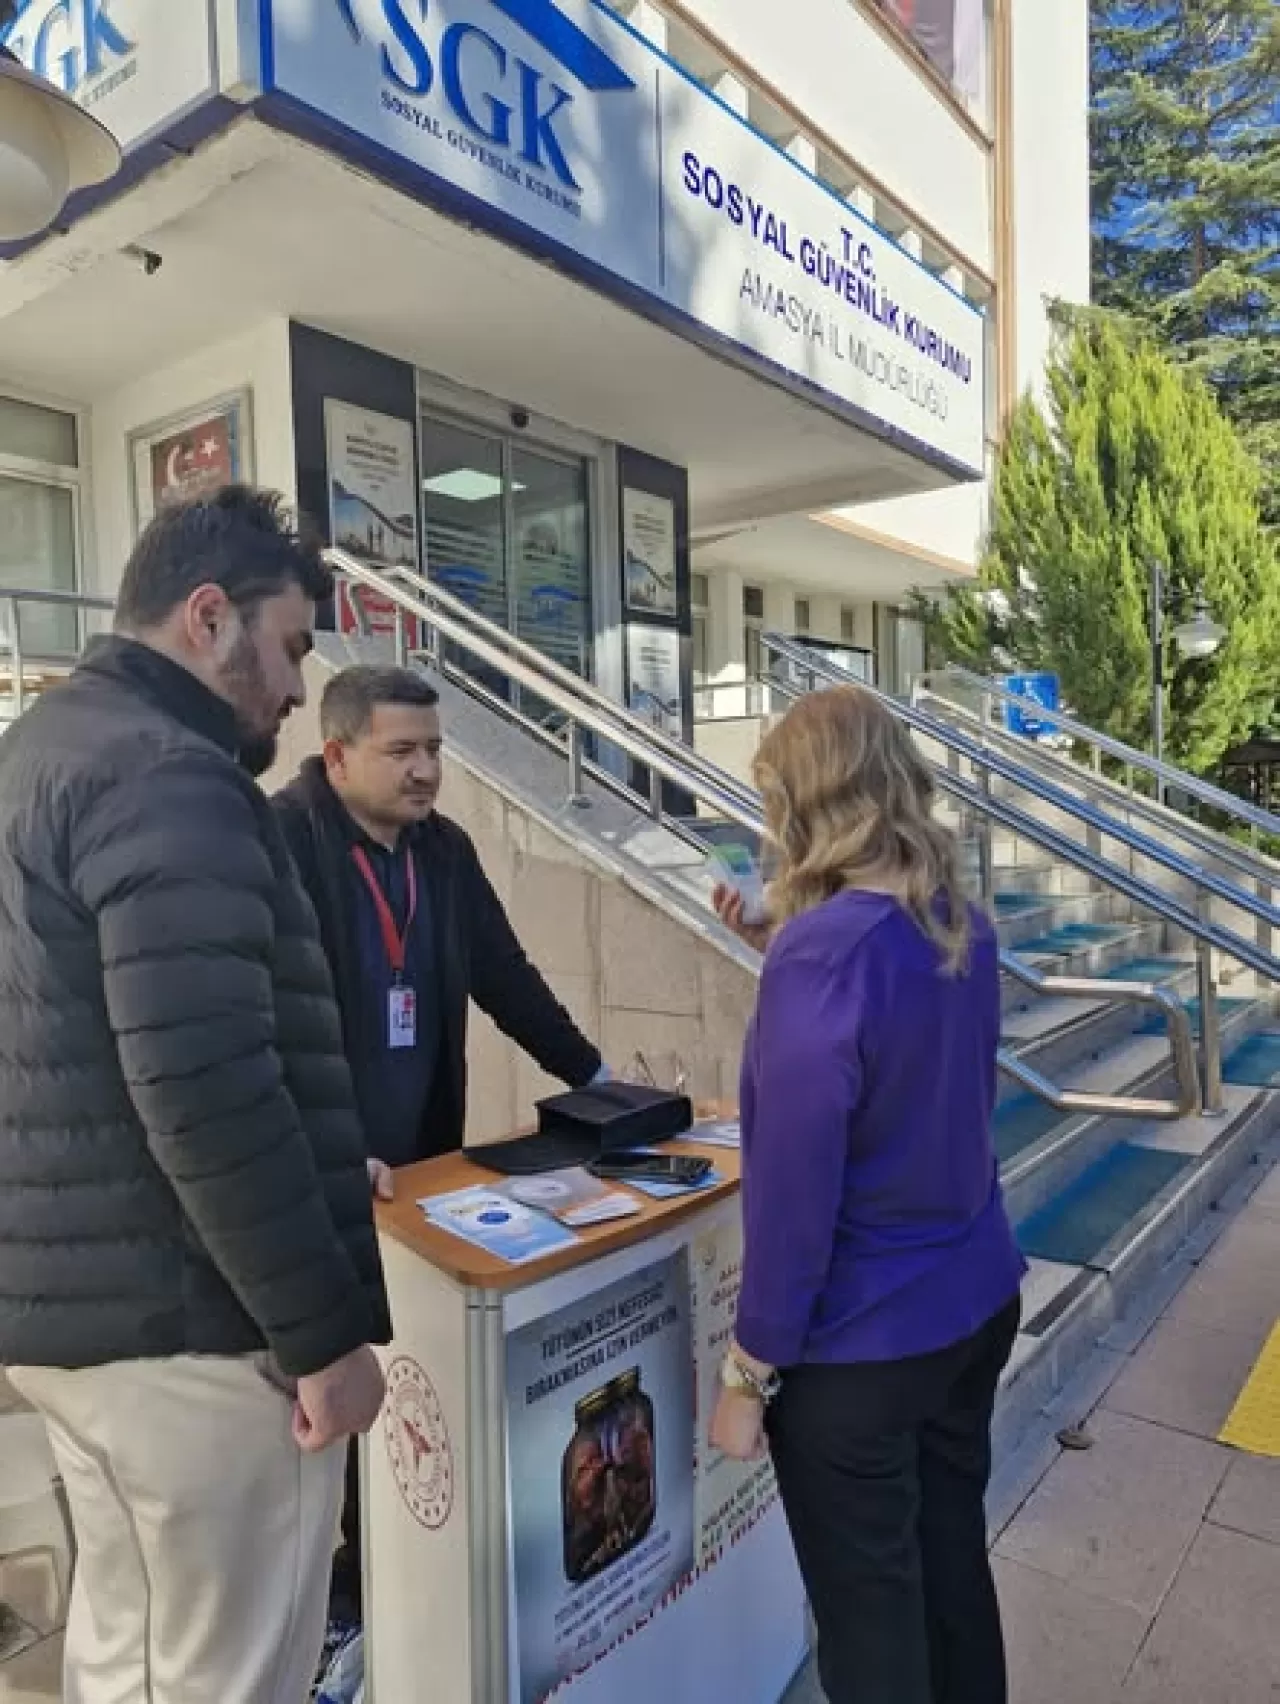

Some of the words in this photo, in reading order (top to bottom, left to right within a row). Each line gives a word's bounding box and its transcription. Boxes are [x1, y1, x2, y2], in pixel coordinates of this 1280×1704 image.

[379, 0, 584, 196] SGK
[380, 89, 442, 139] SOSYAL
[682, 150, 795, 263] SOSYAL
[800, 237, 900, 336] GÜVENLİK
[903, 311, 972, 384] KURUMU
[840, 225, 876, 282] T.C.
[740, 268, 824, 347] AMASYA
